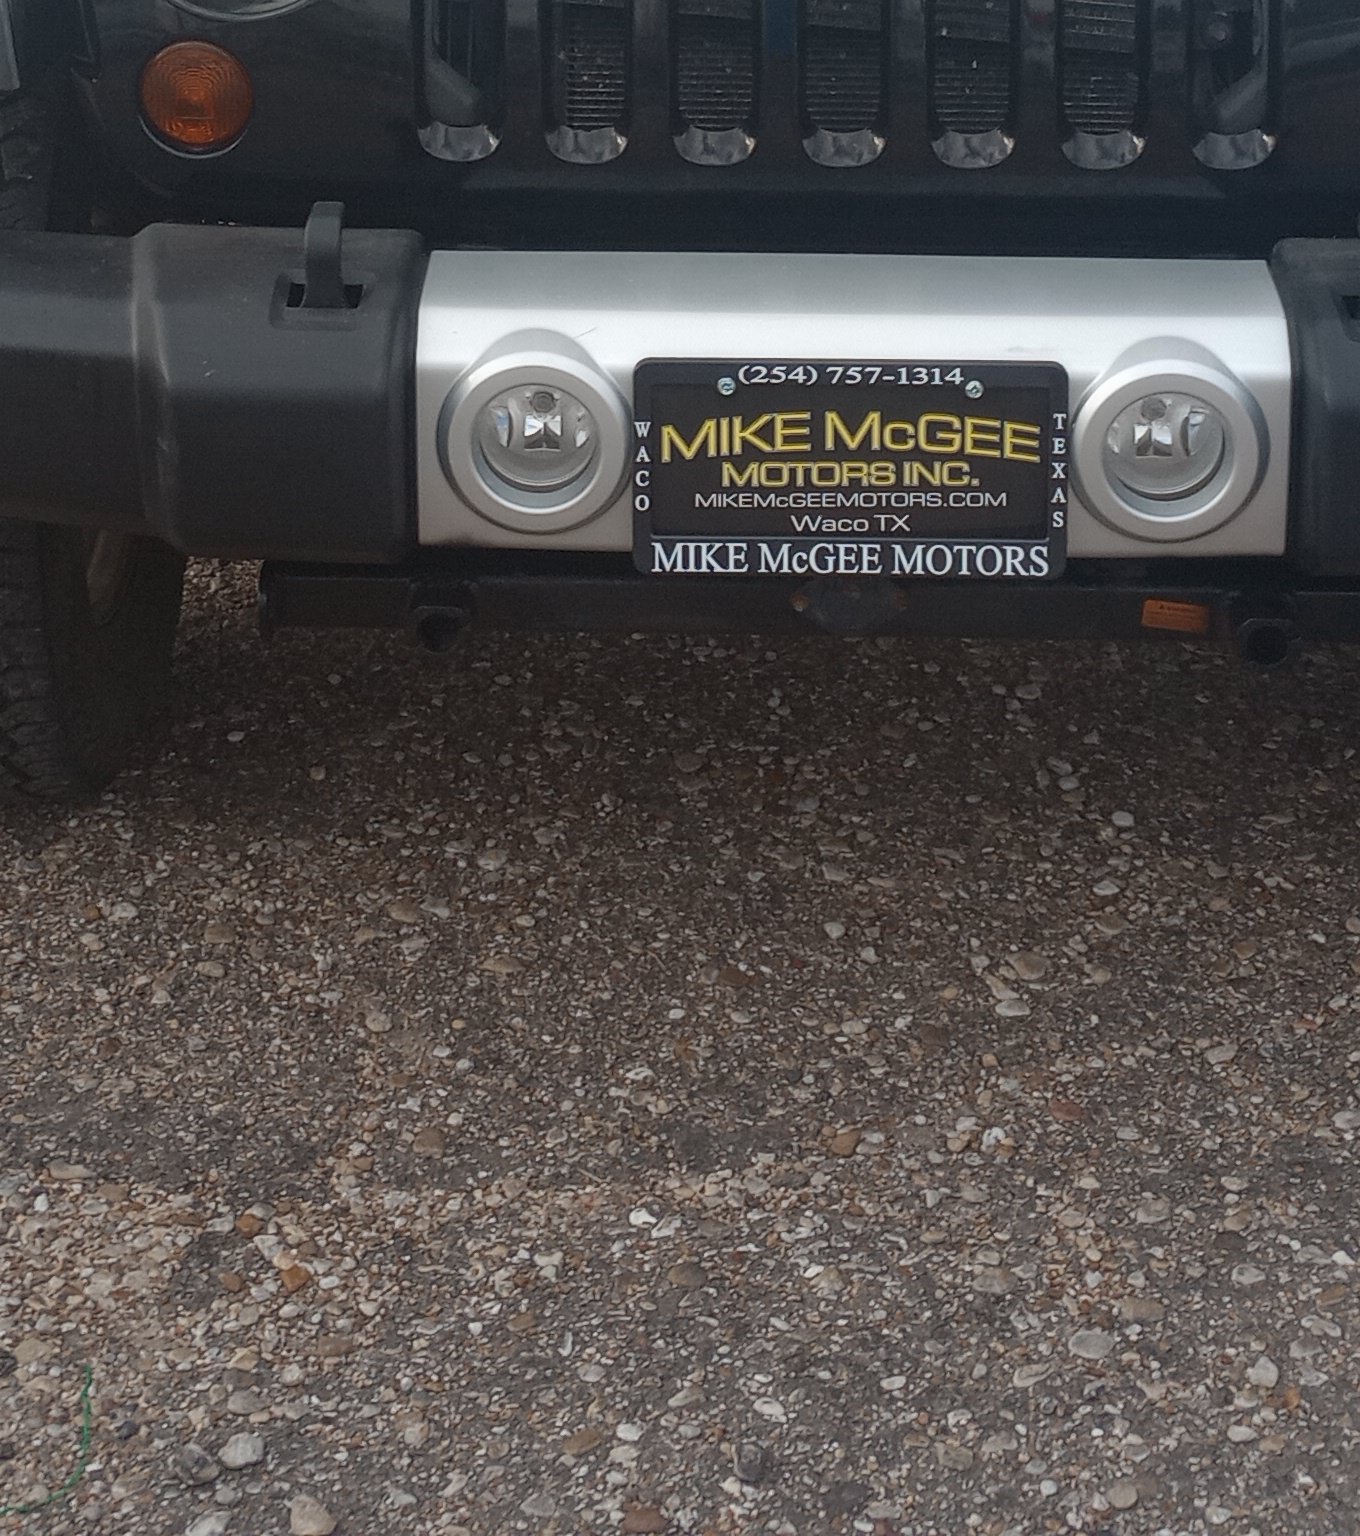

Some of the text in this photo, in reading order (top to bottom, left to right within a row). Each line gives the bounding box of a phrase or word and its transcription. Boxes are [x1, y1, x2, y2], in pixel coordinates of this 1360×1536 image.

[737, 365, 964, 385] (254) 757-1314
[660, 410, 1041, 463] MIKE McGEE
[634, 421, 651, 511] WACO
[721, 461, 981, 488] MOTORS INC.
[1051, 413, 1067, 528] TEXAS
[694, 492, 1008, 508] MIKEMcGEEMOTORS.COM
[790, 514, 912, 532] Waco TX
[650, 542, 1050, 577] MIKE McGEE MOTORS
